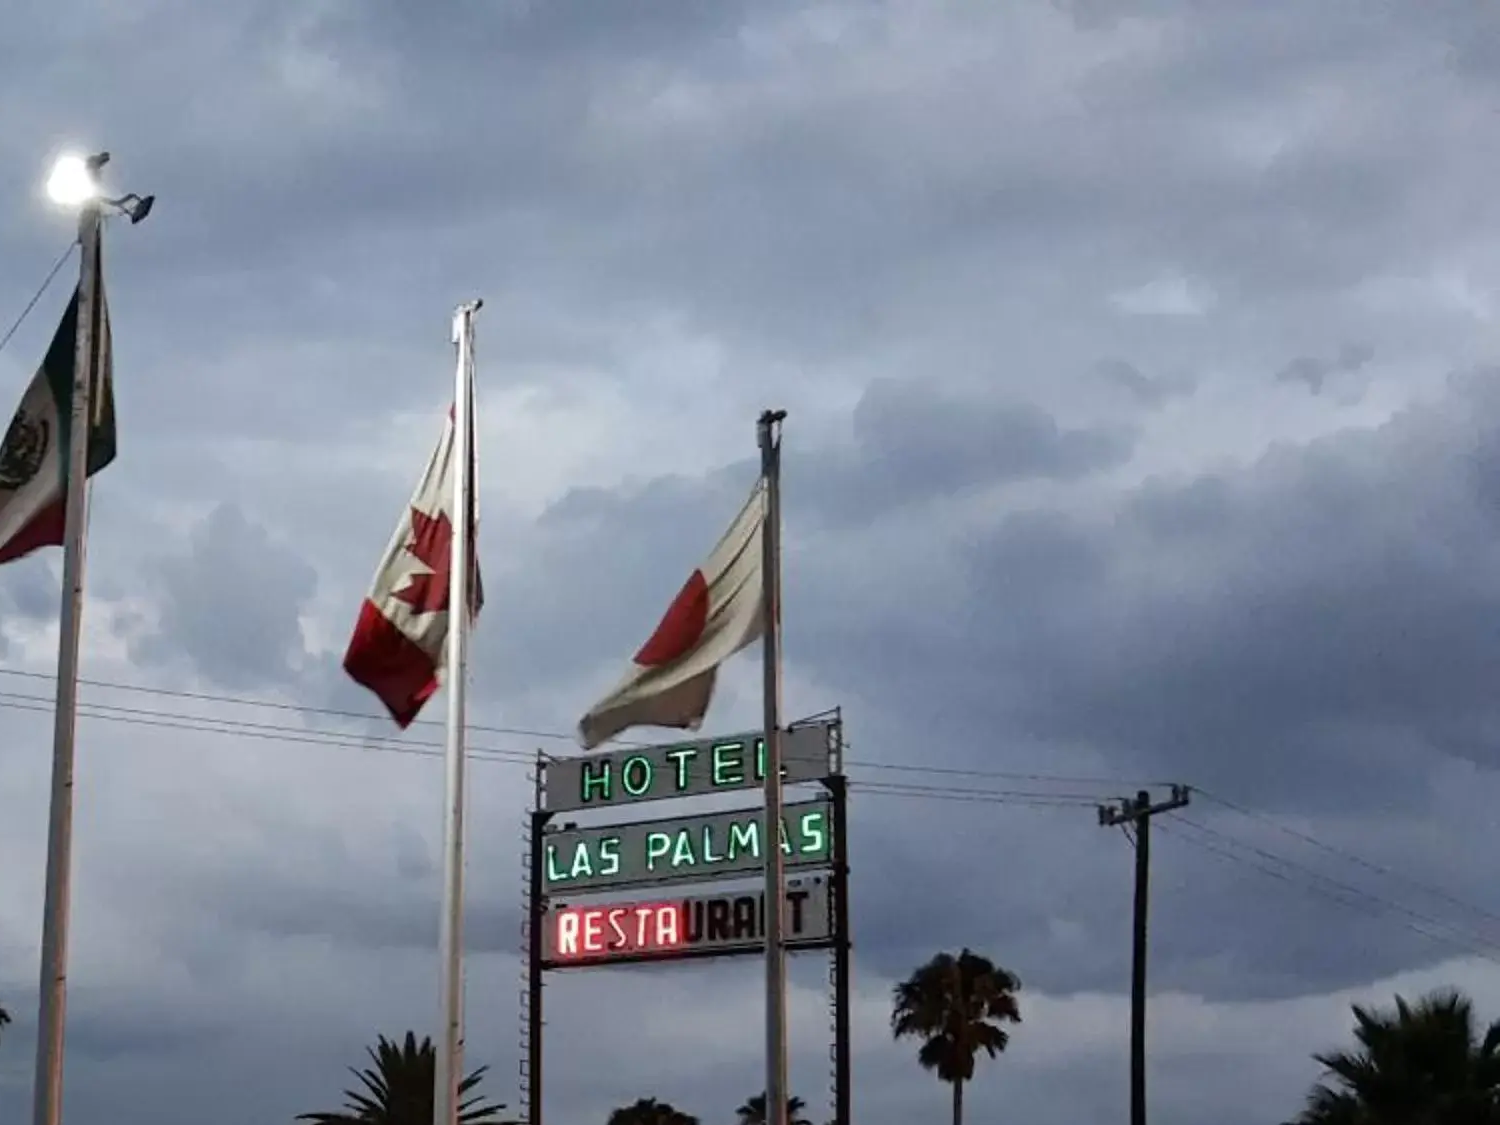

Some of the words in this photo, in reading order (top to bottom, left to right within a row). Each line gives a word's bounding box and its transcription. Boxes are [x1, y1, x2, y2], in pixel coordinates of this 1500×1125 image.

[580, 737, 787, 803] HOTEL
[546, 836, 621, 882] LAS
[646, 812, 824, 873] PALMAS
[556, 890, 810, 956] RESTAURAT
